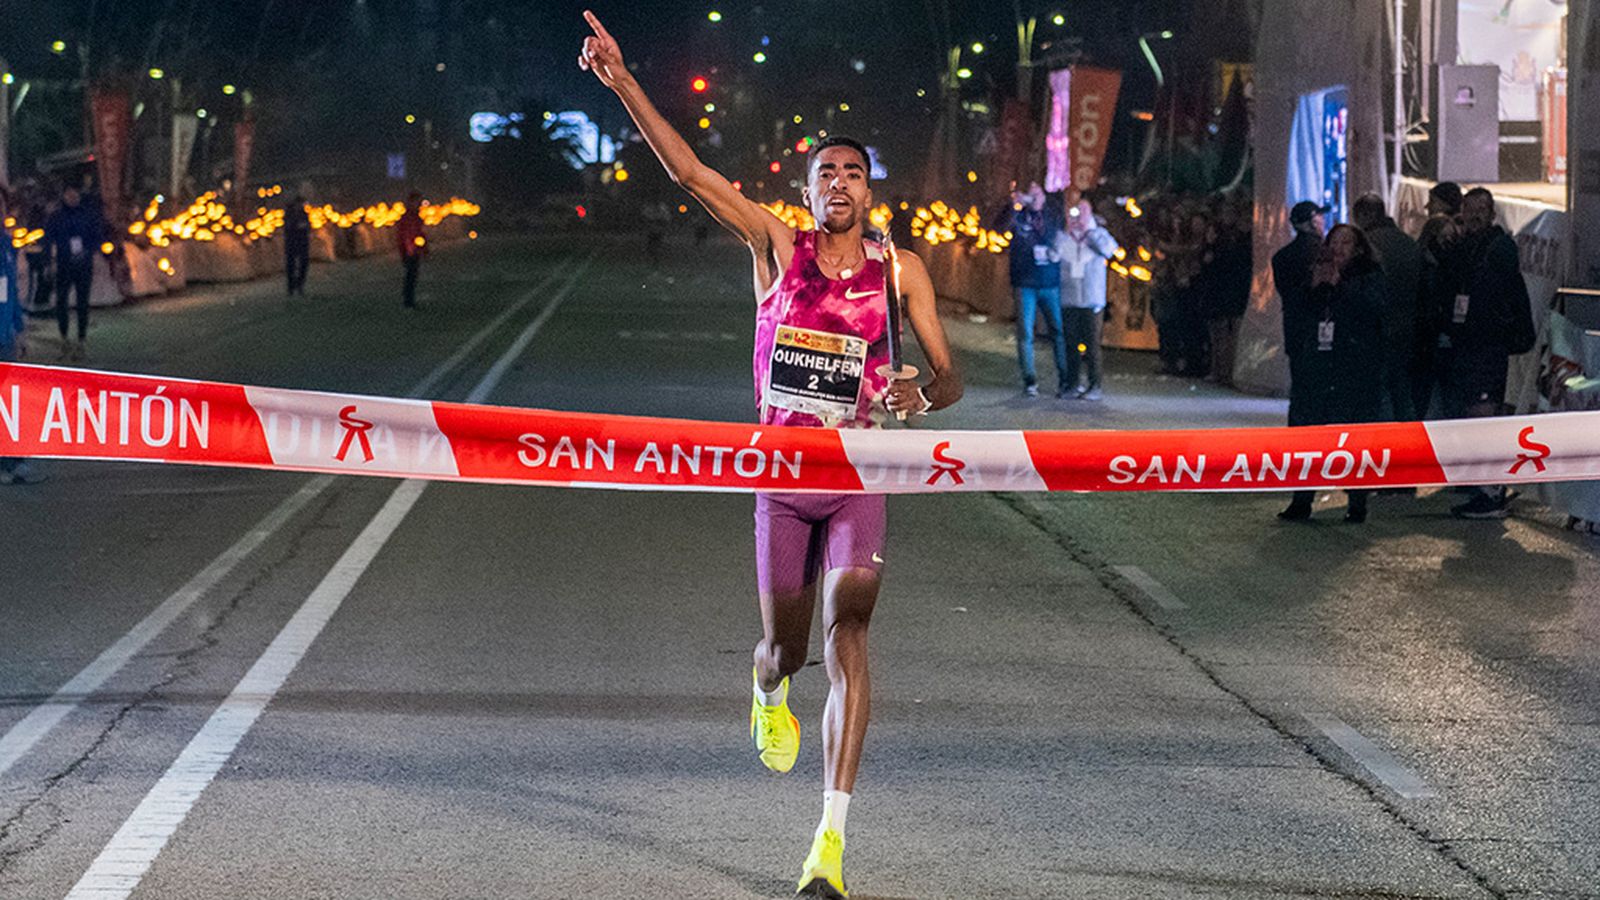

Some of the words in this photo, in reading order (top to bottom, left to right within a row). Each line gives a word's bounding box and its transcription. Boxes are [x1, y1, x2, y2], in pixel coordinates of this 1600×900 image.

[774, 349, 861, 377] OUKHELFEN
[807, 374, 820, 390] 2
[40, 386, 209, 449] ANTÓN
[517, 433, 615, 471] SAN
[634, 431, 803, 479] ANTÓN
[1107, 454, 1206, 484] SAN
[1221, 433, 1391, 483] ANTÓN
